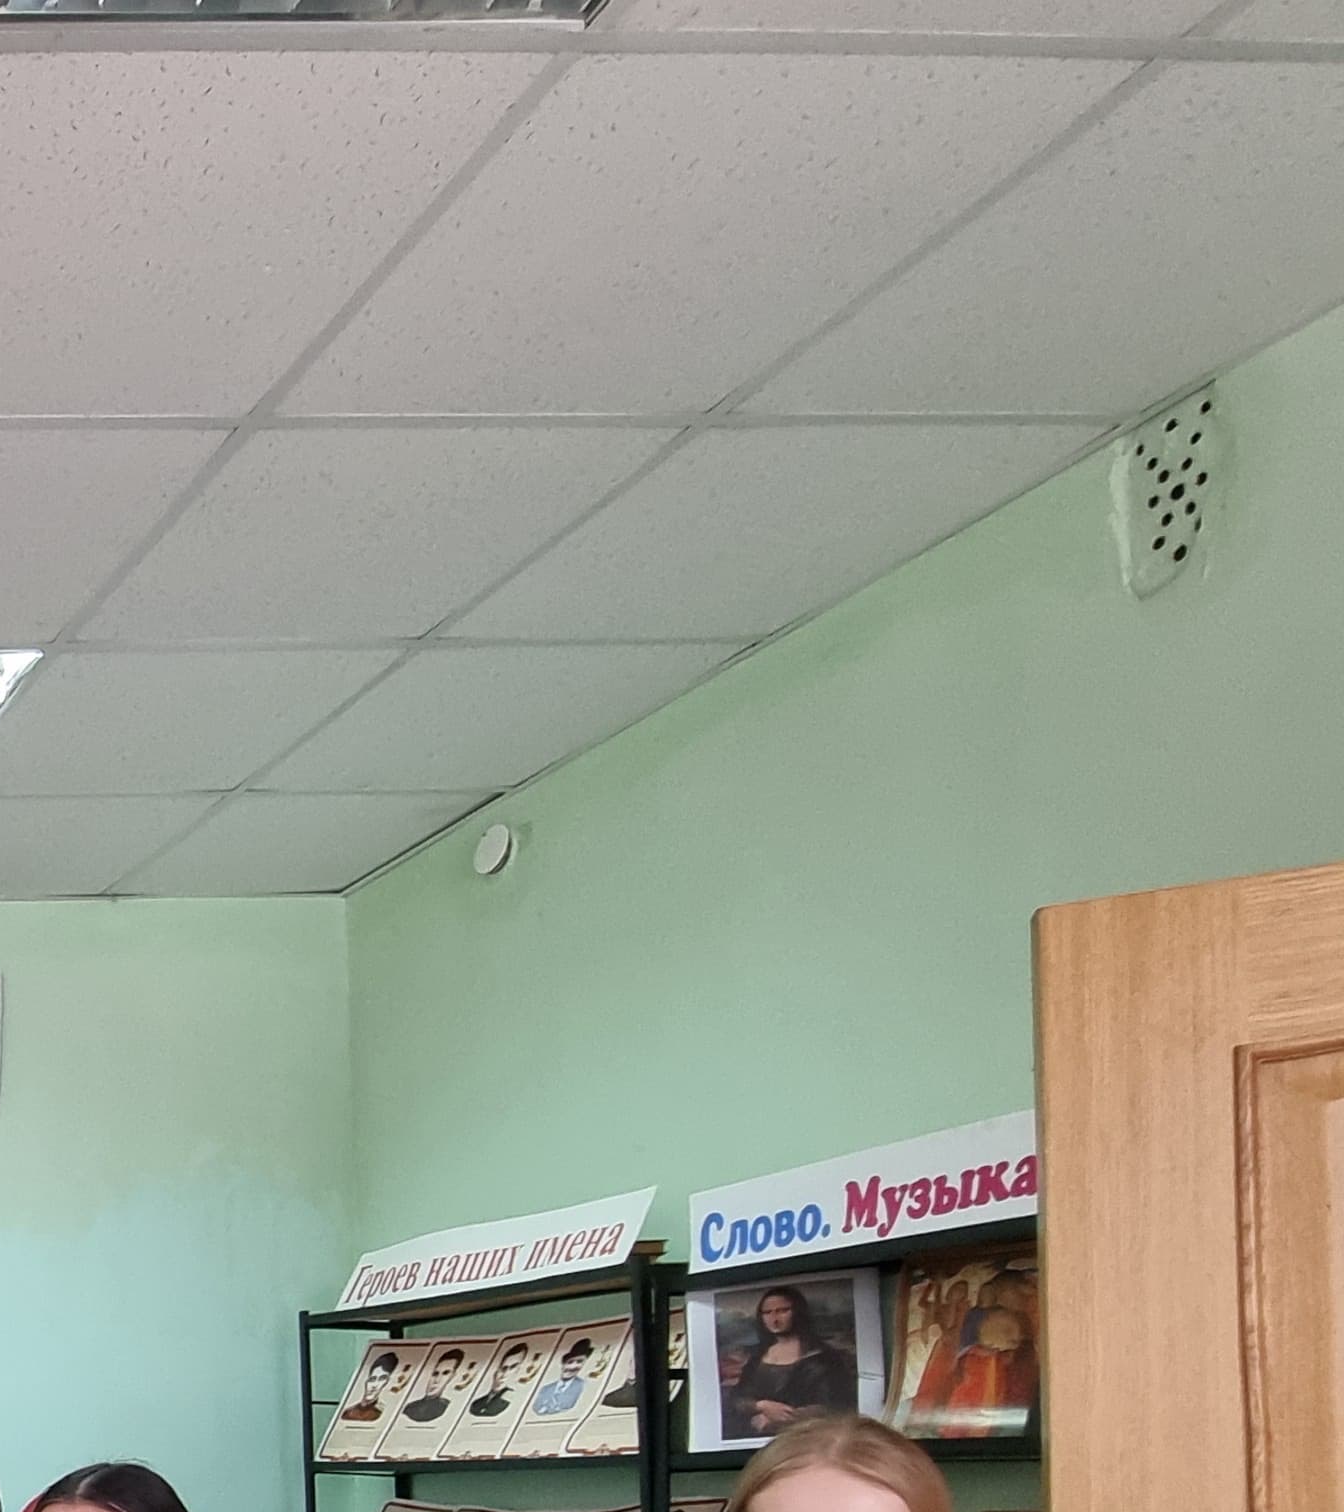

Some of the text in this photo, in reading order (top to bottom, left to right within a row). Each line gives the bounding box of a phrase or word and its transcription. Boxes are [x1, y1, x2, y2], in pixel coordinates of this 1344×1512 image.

[701, 1154, 1038, 1264] Слово. Музыка
[345, 1222, 625, 1305] Героев наших имена
